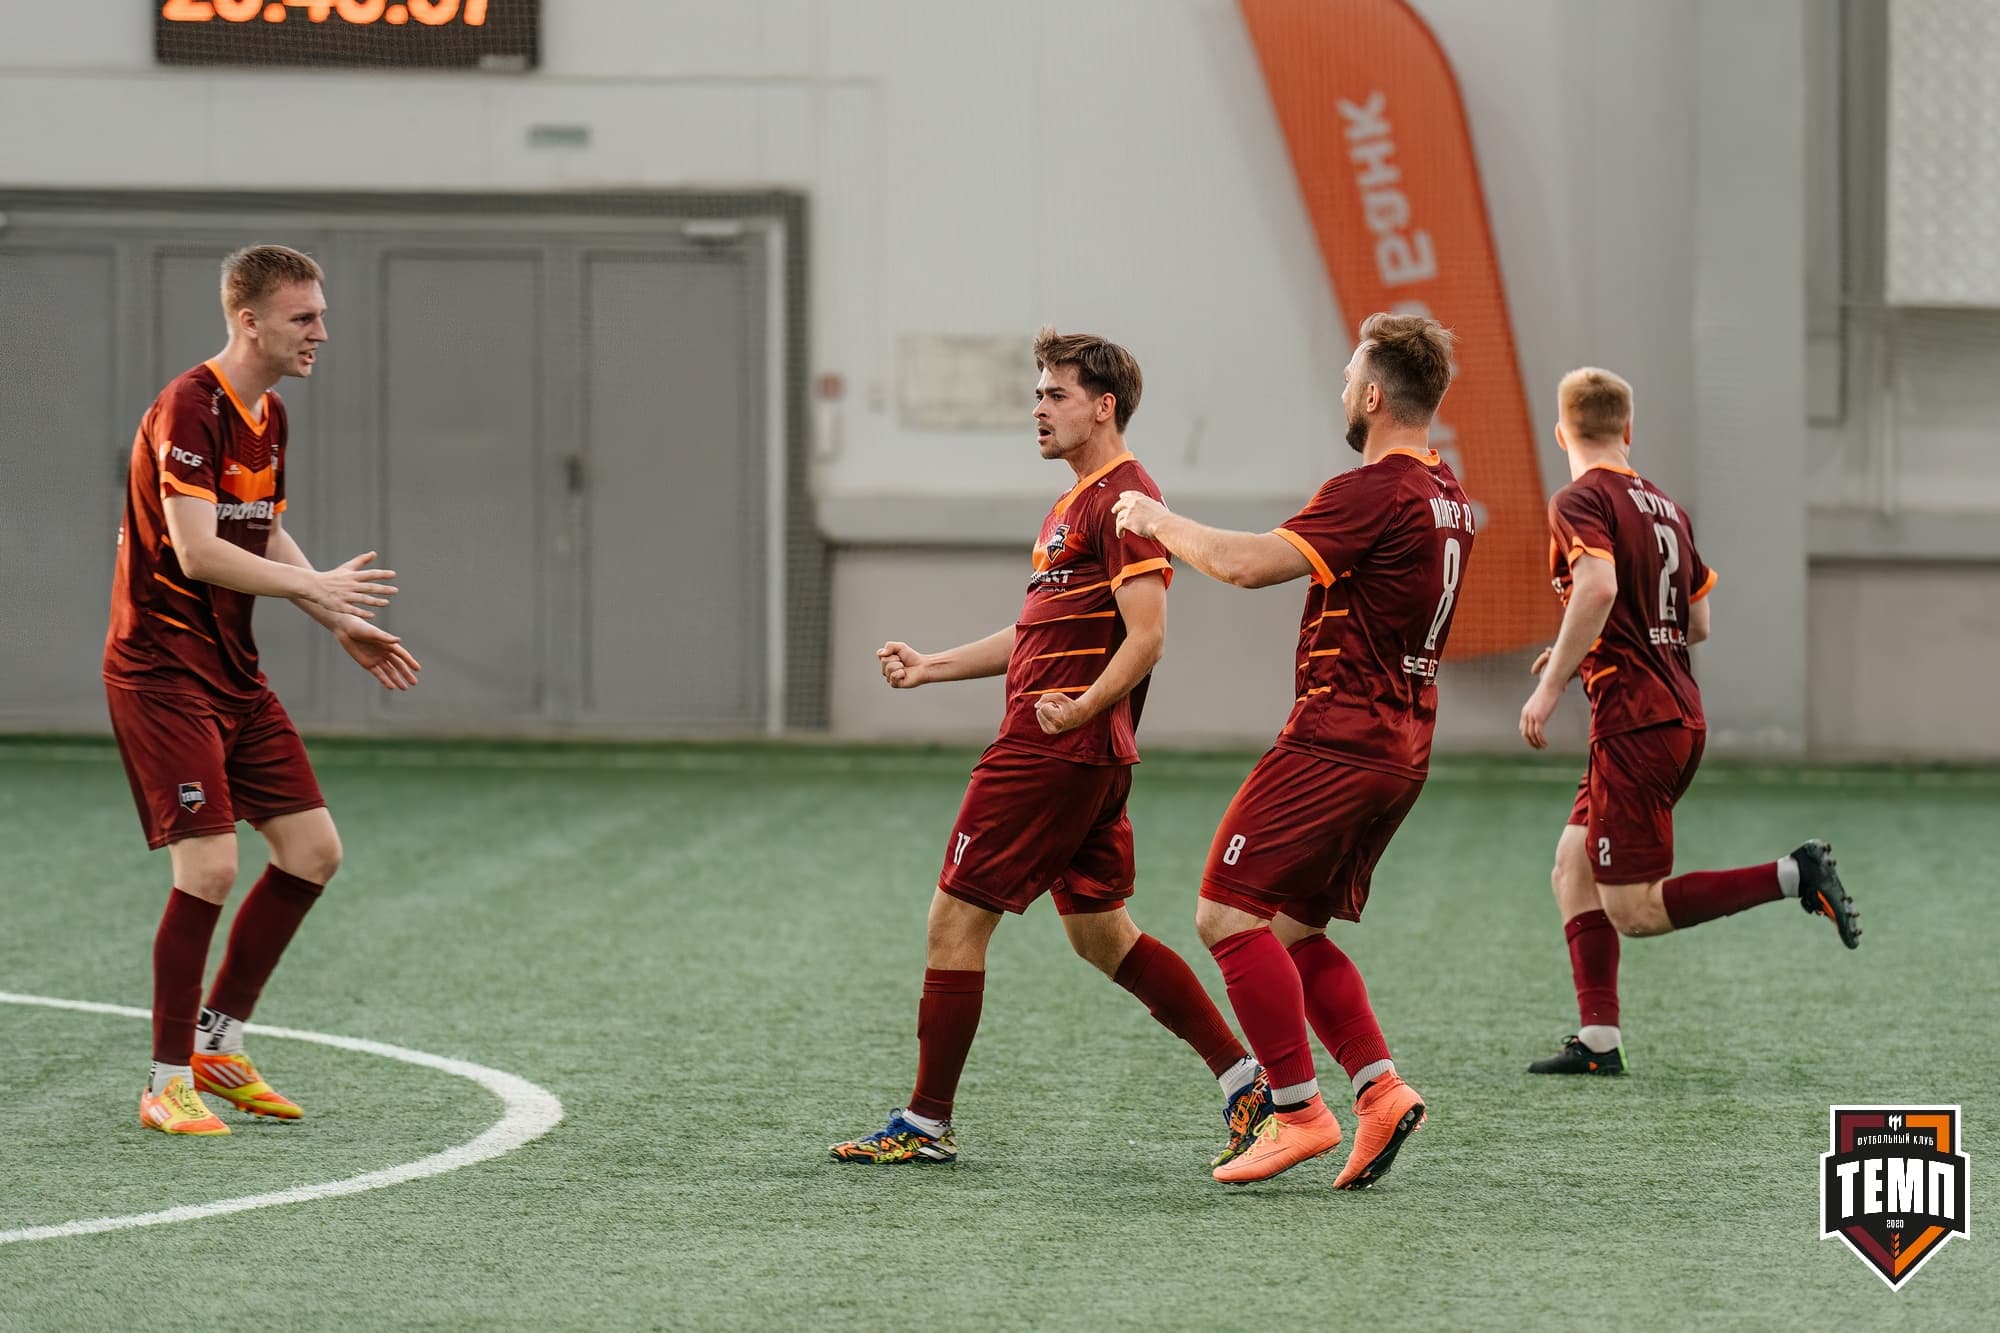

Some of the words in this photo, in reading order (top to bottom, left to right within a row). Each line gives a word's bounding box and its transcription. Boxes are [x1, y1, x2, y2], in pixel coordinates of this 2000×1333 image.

[1424, 537, 1461, 650] 8
[1653, 522, 1680, 621] 2
[1222, 833, 1247, 866] 8
[1598, 837, 1611, 867] 2
